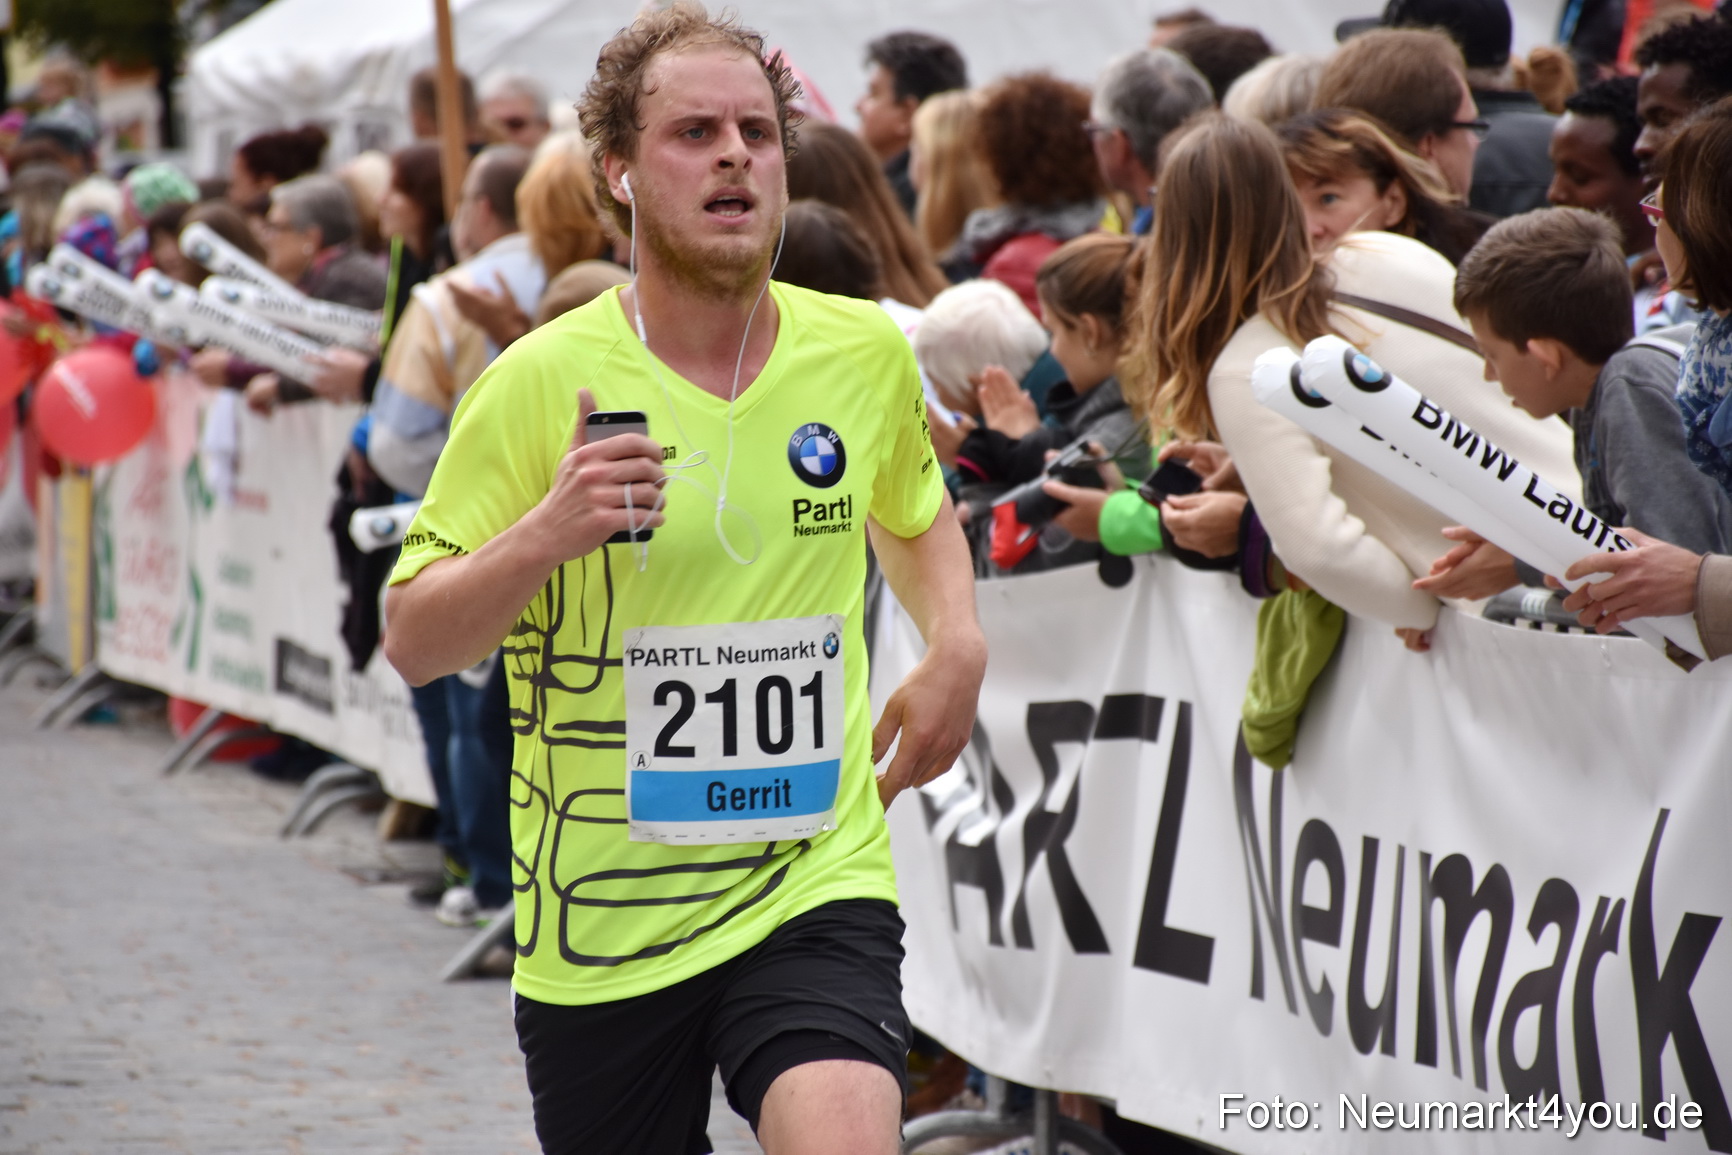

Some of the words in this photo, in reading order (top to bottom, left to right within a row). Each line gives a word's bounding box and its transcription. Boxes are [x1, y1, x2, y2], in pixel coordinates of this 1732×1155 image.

[790, 424, 840, 448] BMW
[1411, 395, 1519, 482] BMW
[793, 494, 852, 524] Partl
[794, 521, 852, 537] Neumarkt
[630, 647, 710, 667] PARTL
[717, 640, 816, 665] Neumarkt
[653, 670, 824, 758] 2101
[636, 754, 646, 767] A
[707, 778, 792, 812] Gerrit
